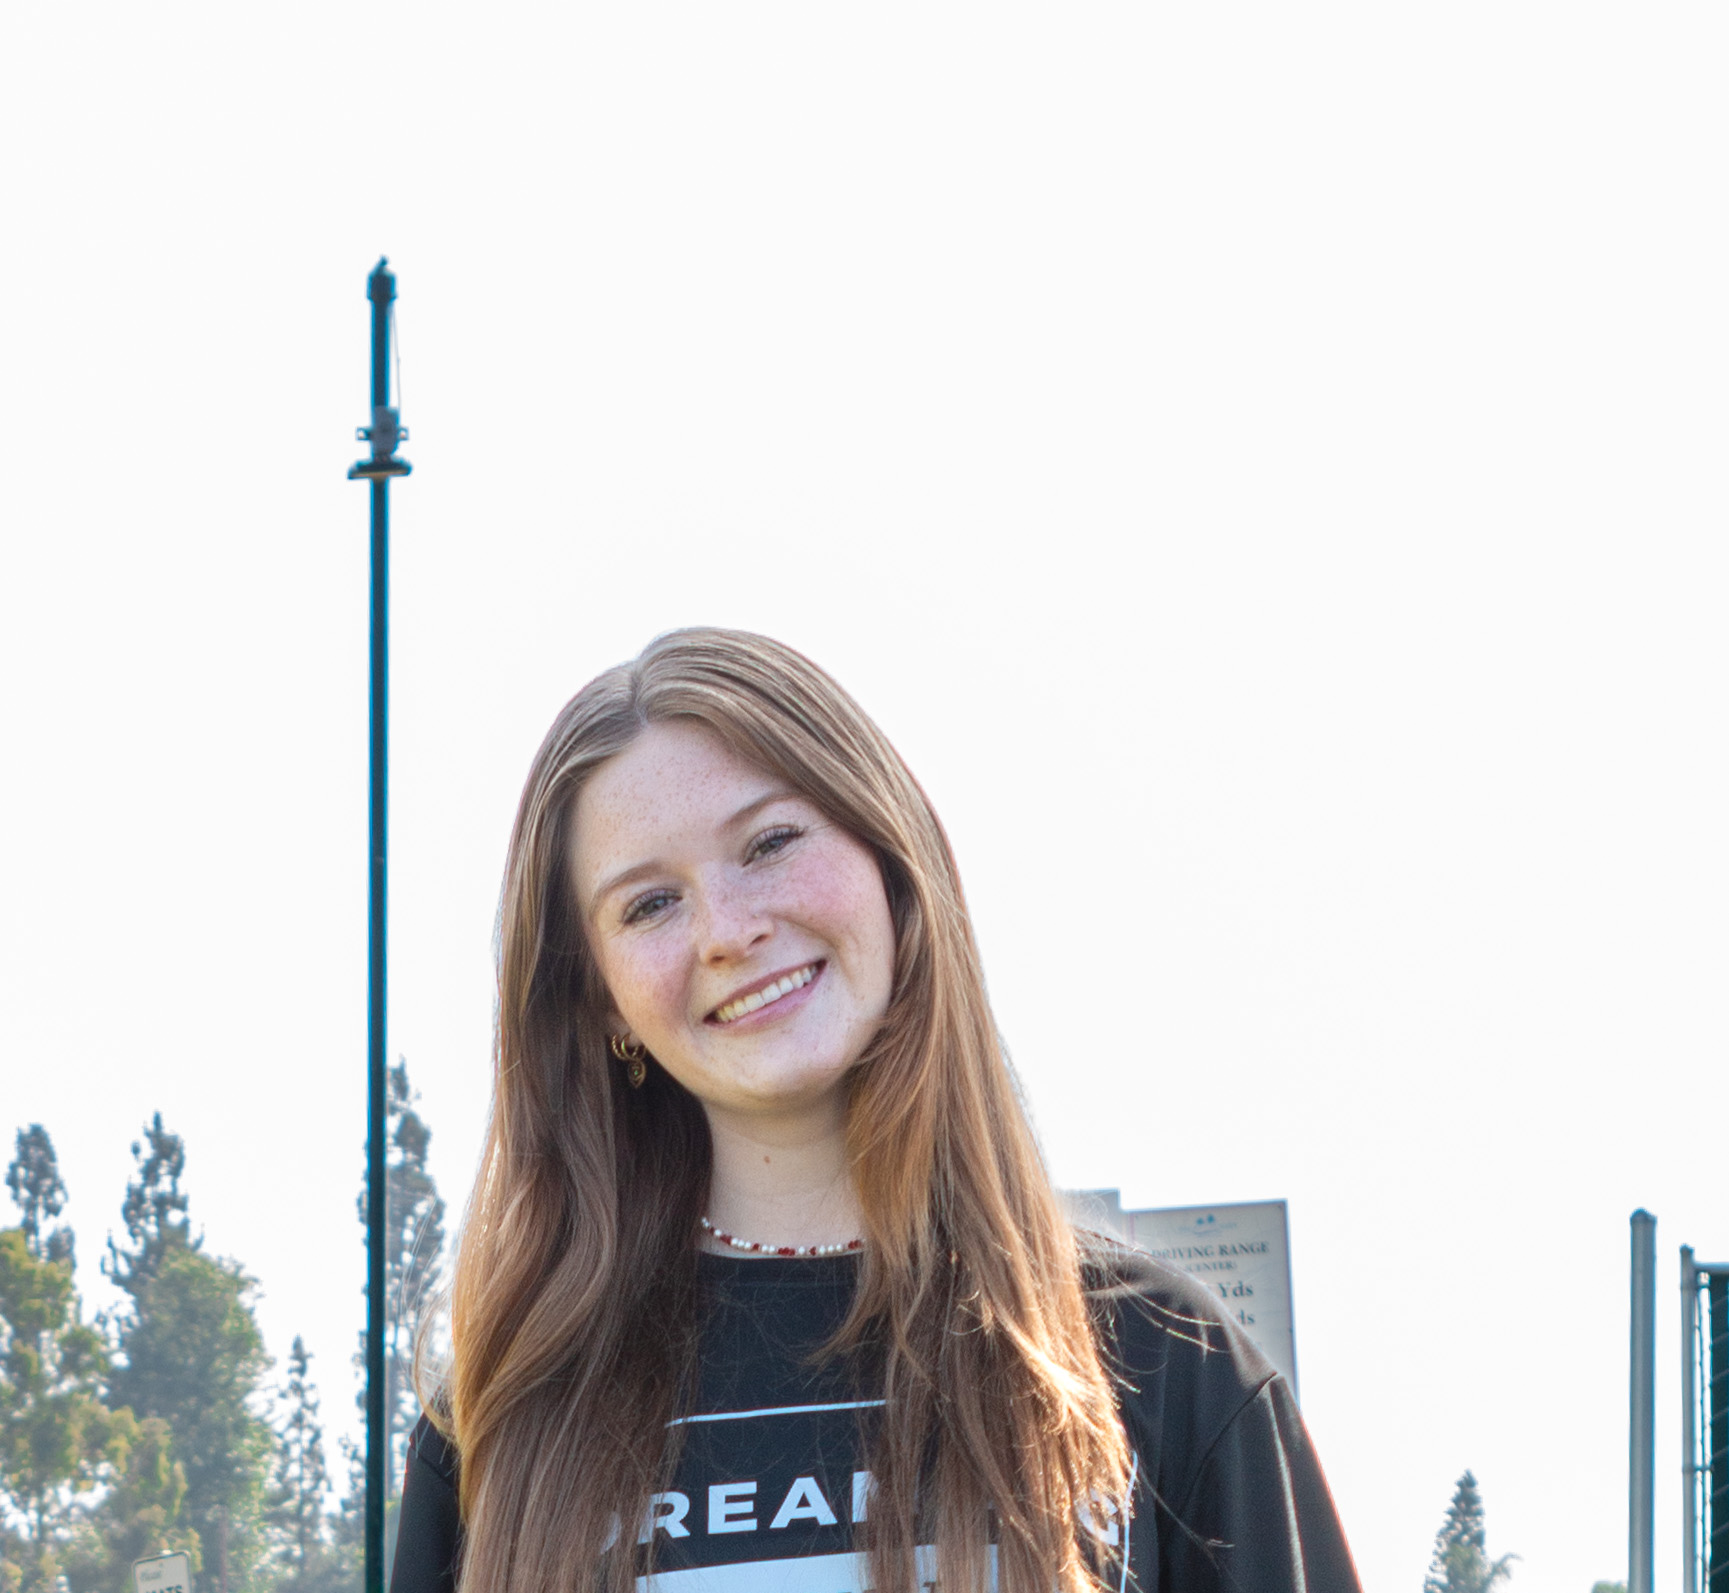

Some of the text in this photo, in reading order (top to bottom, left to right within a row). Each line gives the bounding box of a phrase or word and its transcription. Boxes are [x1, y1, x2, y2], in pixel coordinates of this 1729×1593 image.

[1152, 1241, 1270, 1260] DRIVING RANGE
[1218, 1281, 1255, 1298] Yds
